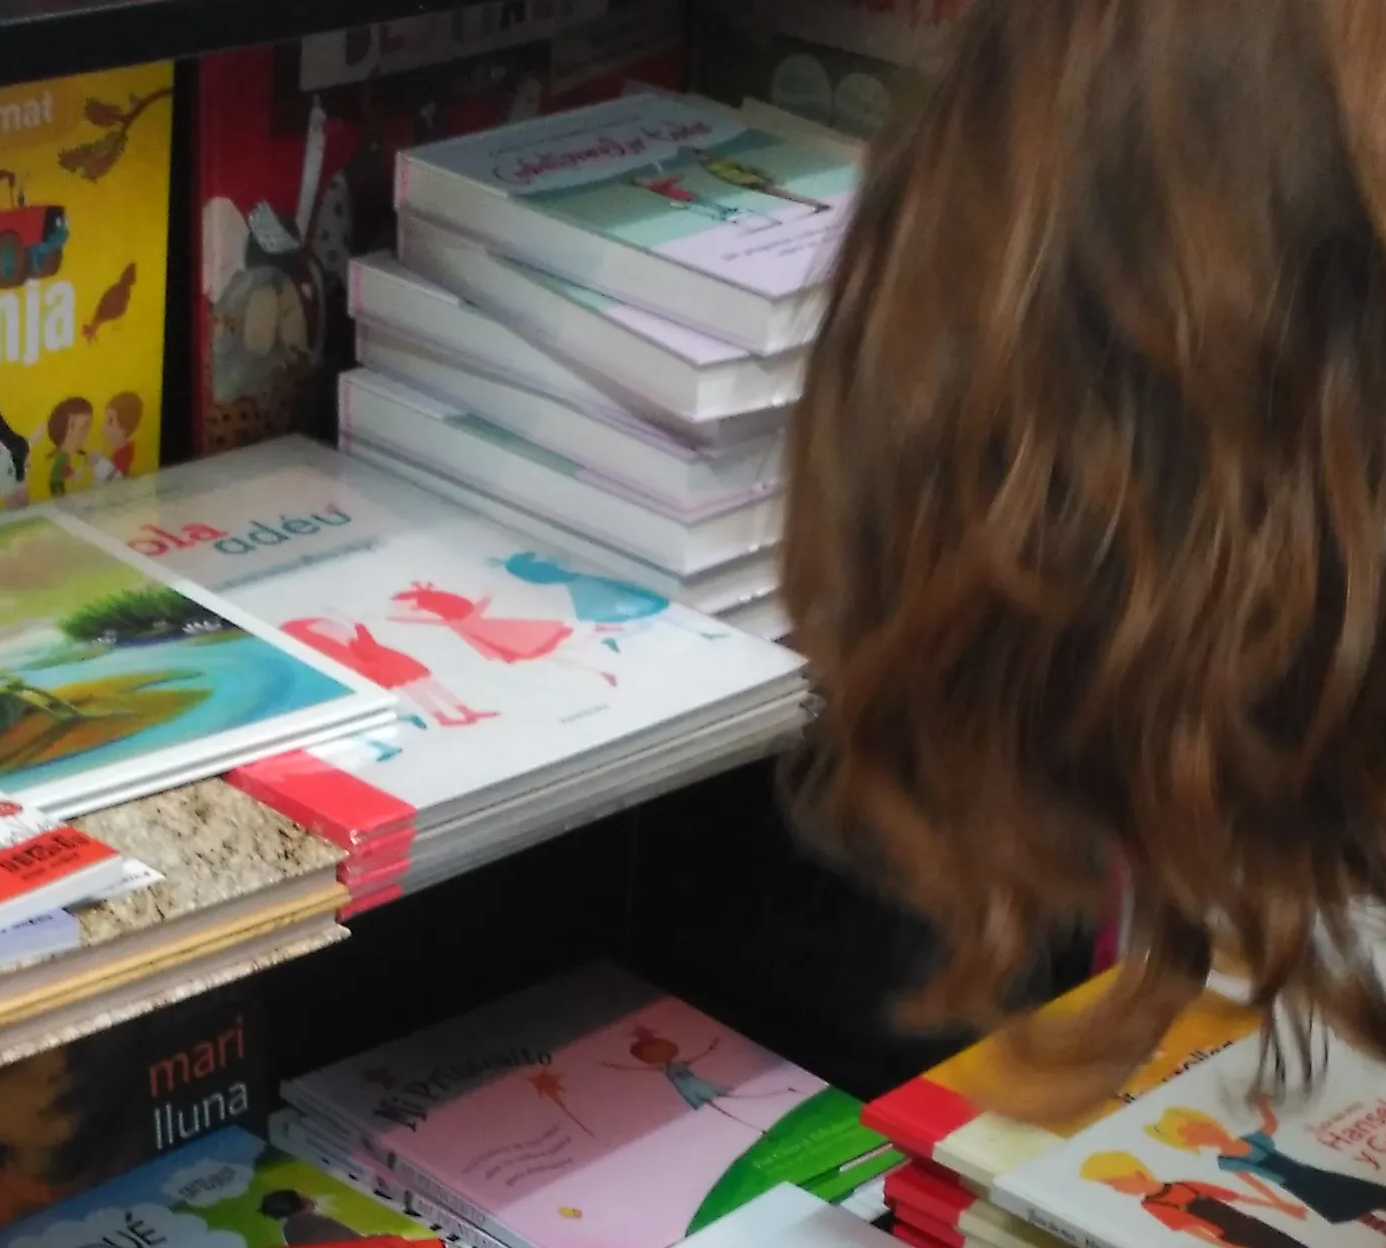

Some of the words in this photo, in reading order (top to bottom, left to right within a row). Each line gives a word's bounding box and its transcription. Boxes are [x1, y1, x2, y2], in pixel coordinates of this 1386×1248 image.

[127, 523, 229, 557] ola
[213, 503, 352, 555] adéu
[148, 1013, 245, 1098] mari
[153, 1081, 249, 1150] lluna
[1353, 1151, 1380, 1170] y
